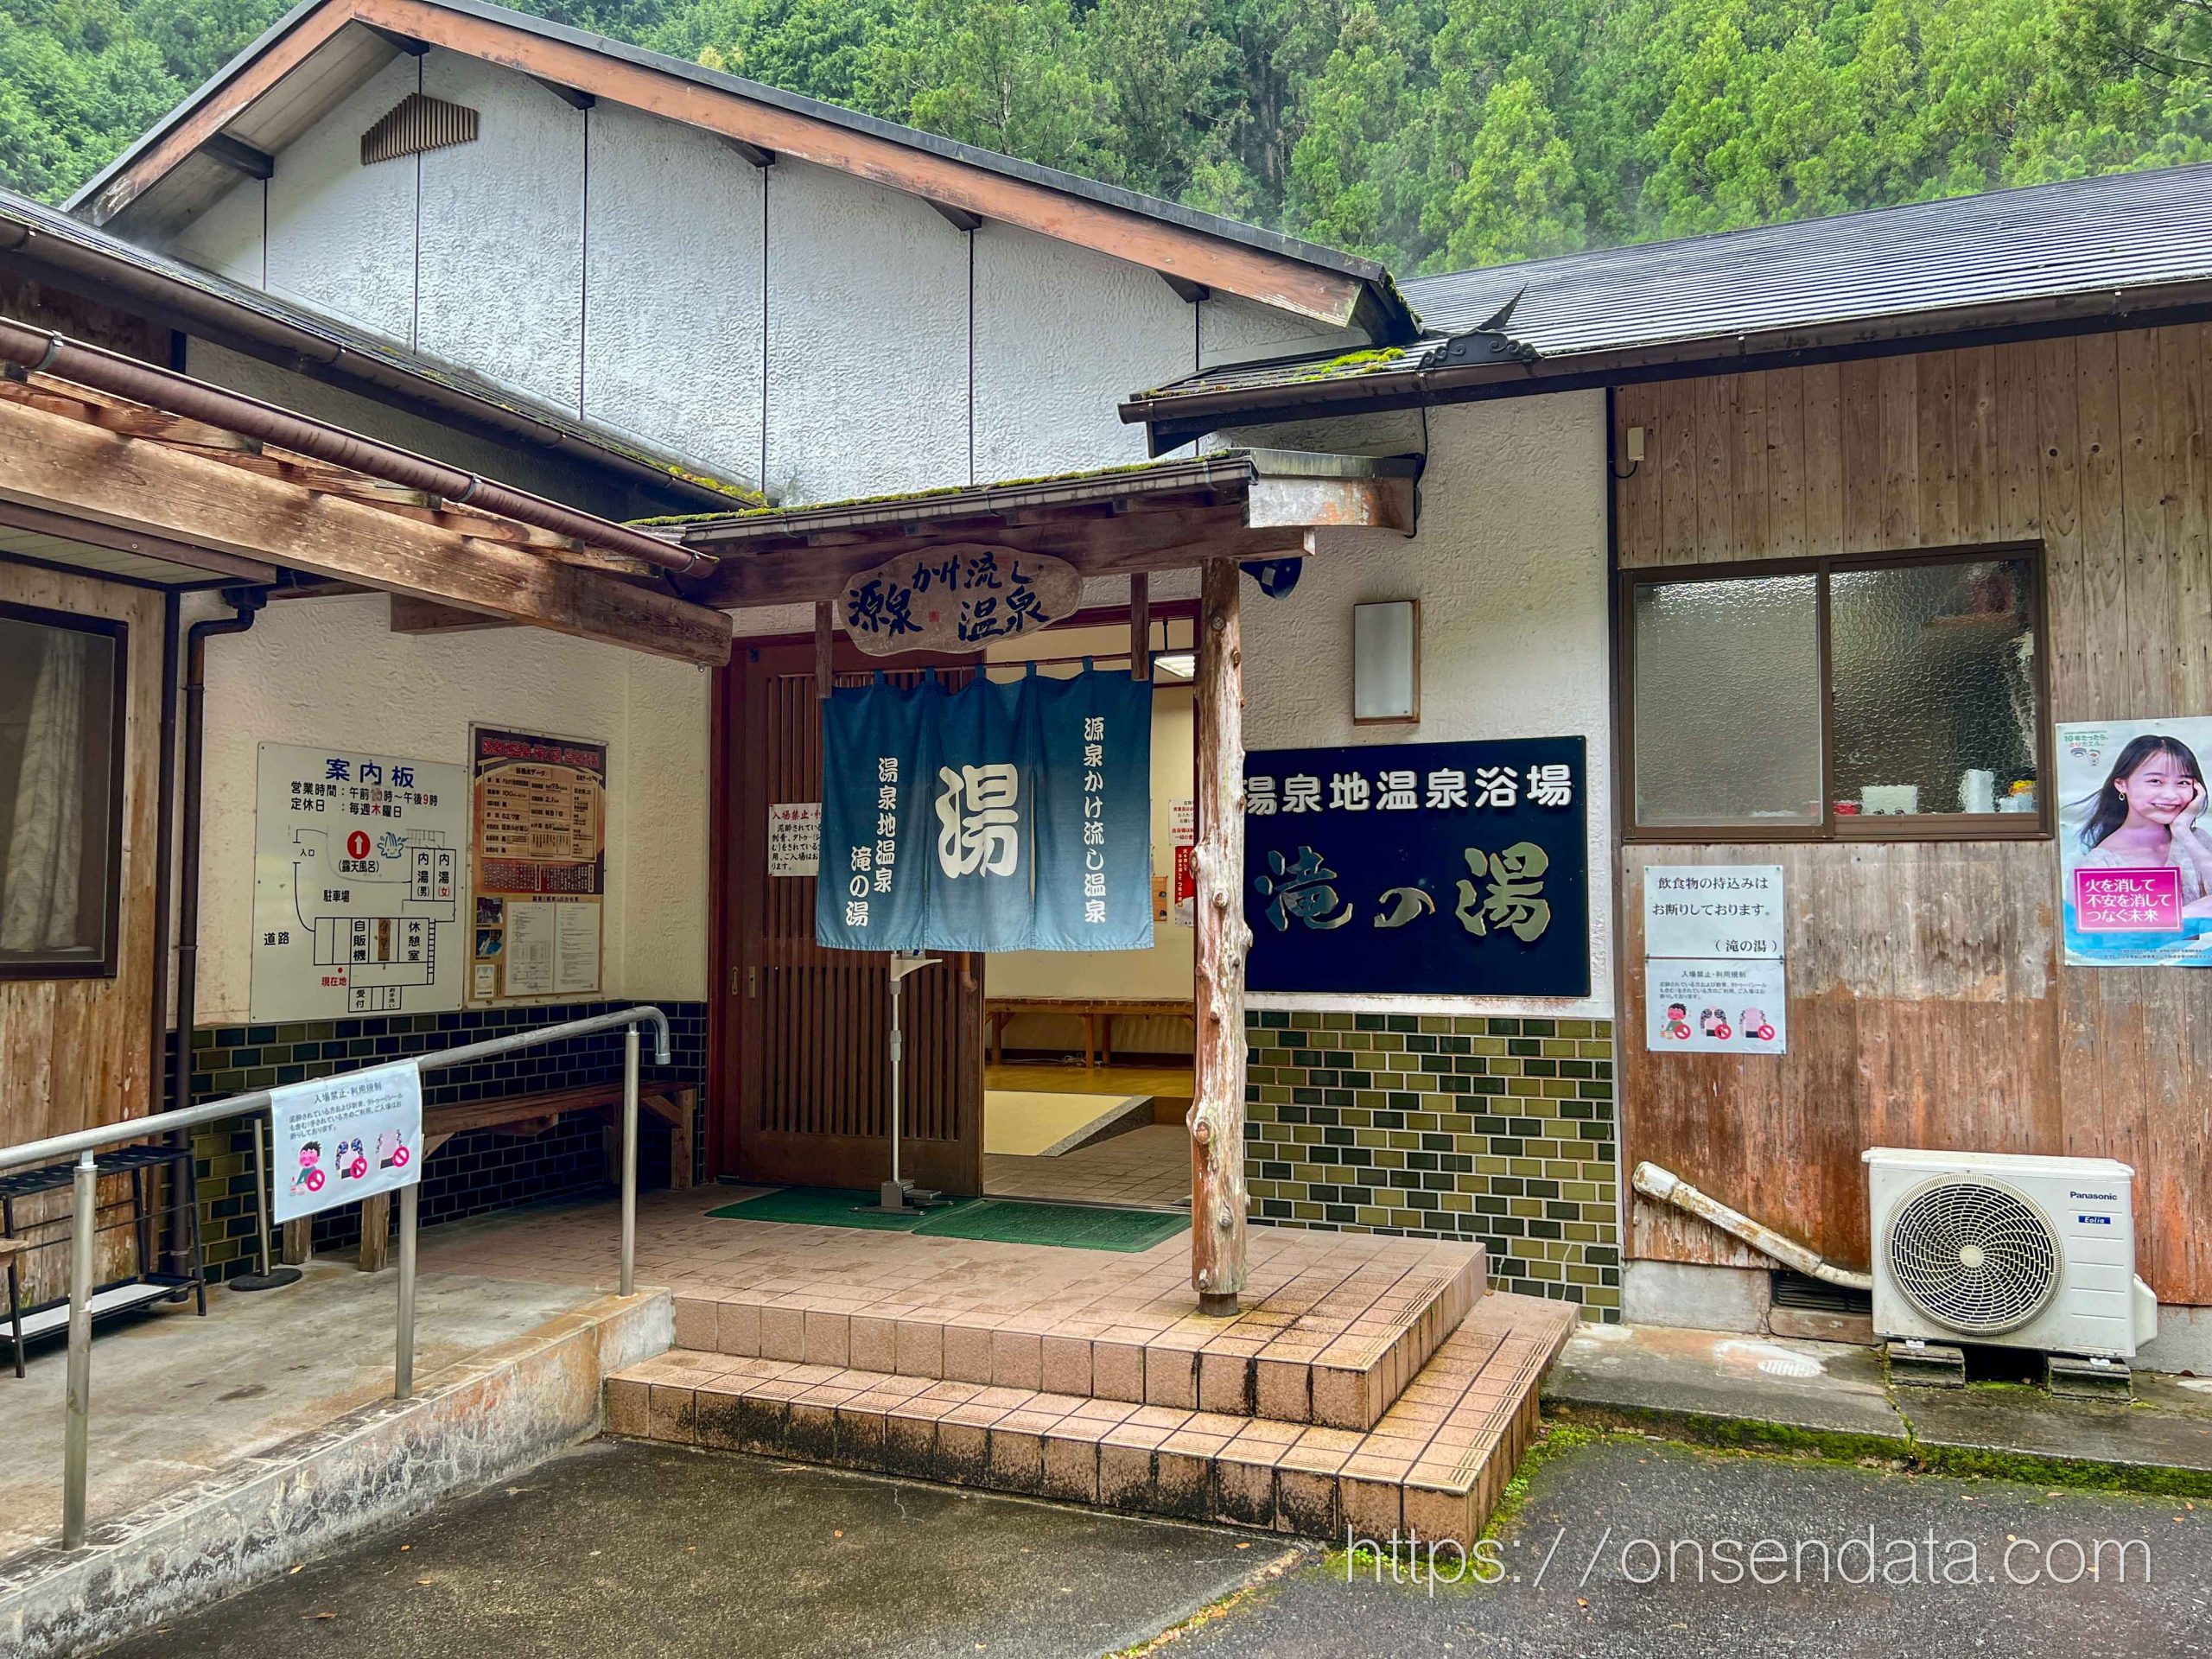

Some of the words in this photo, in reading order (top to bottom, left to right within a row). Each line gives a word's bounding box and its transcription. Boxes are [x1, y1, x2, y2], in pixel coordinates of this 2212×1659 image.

[957, 585, 1051, 642] 温泉
[325, 758, 415, 789] 案内板
[874, 757, 899, 893] 湯泉地温泉
[934, 762, 1019, 880] 湯
[1084, 716, 1107, 924] 源泉かけ流し温泉
[300, 849, 315, 857] 入口
[338, 860, 379, 873] (露天風呂)
[845, 846, 872, 927] 滝の湯
[1253, 841, 1551, 943] 滝の湯
[1658, 877, 1769, 890] 飲食物の持込みは
[2085, 878, 2156, 893] 火を消して
[323, 889, 350, 903] 駐車場
[2086, 893, 2171, 908] 不安を消して
[1652, 903, 1770, 917] お断りしております。
[2087, 908, 2158, 923] つなぐ未来
[264, 931, 290, 946] 道路
[353, 920, 366, 962] 自販機
[408, 921, 421, 961] 休憩室
[321, 976, 347, 987] 現在地
[356, 989, 365, 1008] 受付
[314, 1081, 382, 1104] 入場禁止・利用規制
[2069, 1191, 2119, 1200] Panasonic
